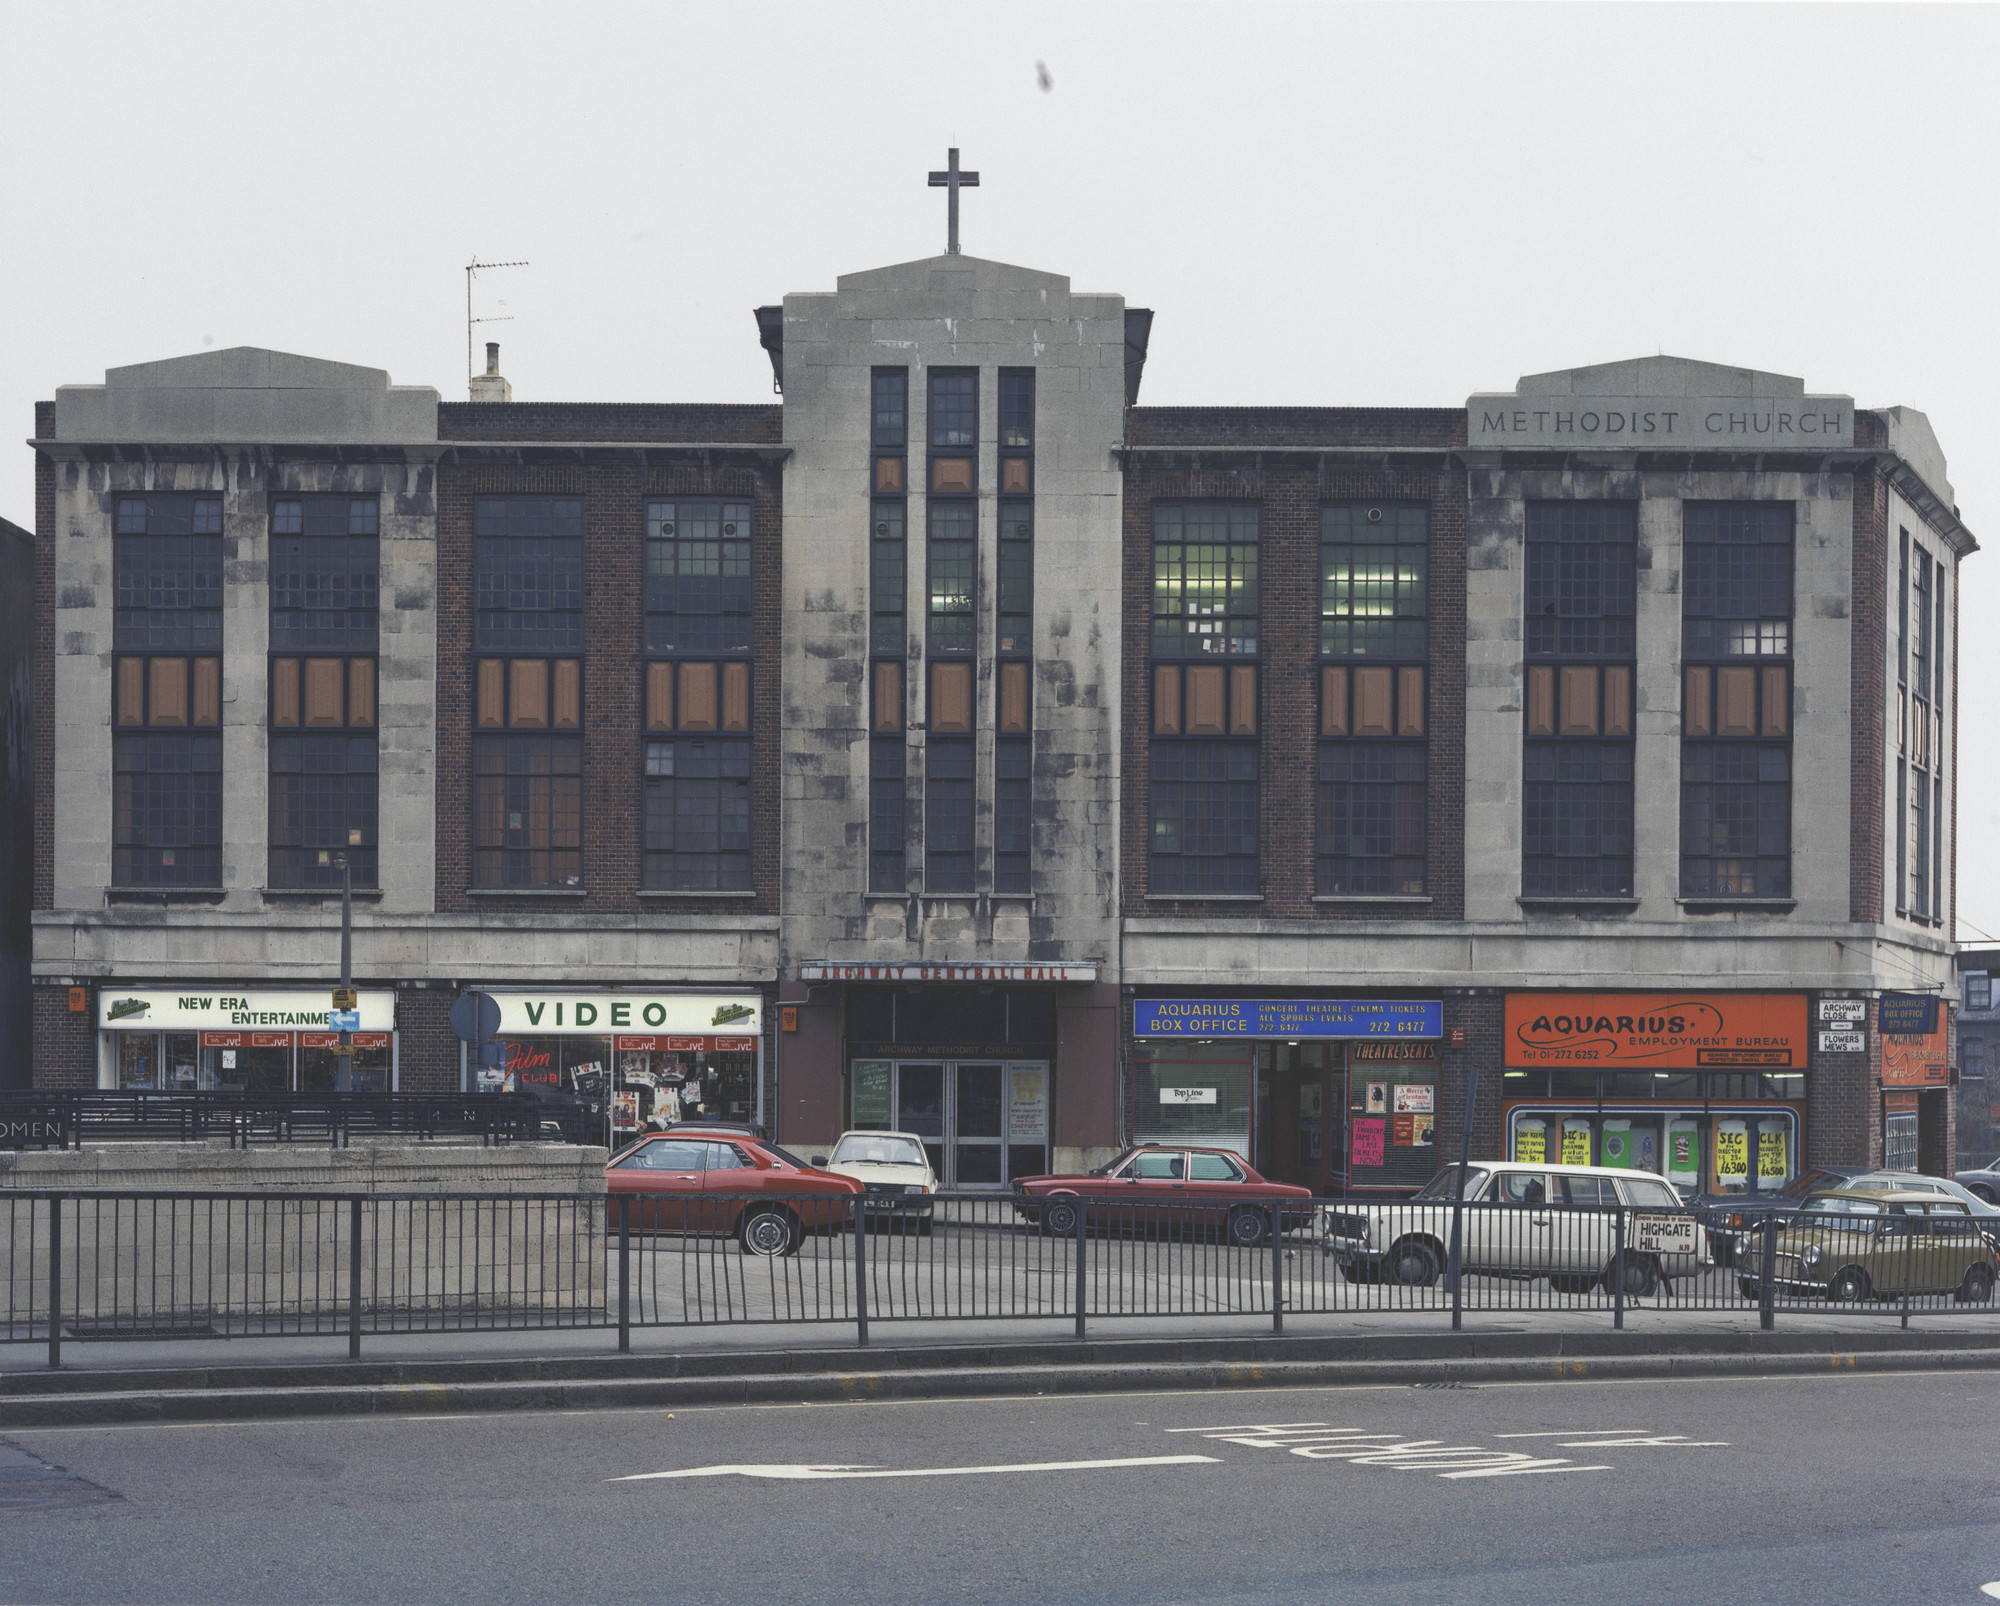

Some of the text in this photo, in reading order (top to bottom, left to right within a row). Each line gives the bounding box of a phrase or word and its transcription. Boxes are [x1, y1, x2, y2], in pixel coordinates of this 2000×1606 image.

[1481, 412, 1841, 434] METHODIST CHURCH
[821, 967, 1068, 980] ARCHWAY CENTRAL HALL
[179, 998, 249, 1010] NEW ERA
[1351, 1005, 1384, 1013] CINEMA
[1390, 1005, 1426, 1013] TICKETS
[1823, 1004, 1862, 1012] ARCHWAY
[1884, 1000, 1926, 1008] AQUARIUS
[525, 1002, 667, 1026] VIDEO
[1158, 1004, 1240, 1016] AQUARIUS
[1884, 1010, 1924, 1018] BOX OFFICE
[232, 1012, 329, 1025] ENTERTAINME
[1280, 1014, 1315, 1022] SPORTS
[1321, 1015, 1354, 1023] EVENTS
[1823, 1012, 1847, 1020] CLOSE
[1151, 1020, 1247, 1031] BOX OFFICE
[1369, 1022, 1425, 1032] 272 6477
[1531, 1015, 1685, 1034] AQUARIUS
[1902, 1020, 1919, 1028] 6477
[224, 1039, 240, 1047] JVC
[272, 1039, 288, 1047] JVC
[370, 1039, 387, 1047] JVC
[1629, 1037, 1789, 1046] EMPLOYMENT BUREAU
[1824, 1035, 1859, 1043] FLOWERS
[638, 1042, 656, 1050] JVC
[878, 1046, 1024, 1054] ARCHWAY METHODIST CHURCH
[1356, 1043, 1435, 1059] THEATRE SEATS
[1824, 1043, 1848, 1051] MEWS
[1522, 1050, 1536, 1059] Tel
[1575, 1050, 1599, 1059] 6252
[504, 1042, 550, 1079] Film
[521, 1073, 558, 1083] CLUB
[0, 1122, 60, 1138] OMEN
[1720, 1132, 1742, 1144] SEC
[1760, 1133, 1782, 1144] CLK
[1720, 1161, 1746, 1174] £6300
[1761, 1164, 1784, 1176] £4500
[1641, 1223, 1691, 1237] HIGHGATE
[1640, 1237, 1661, 1250] HILL
